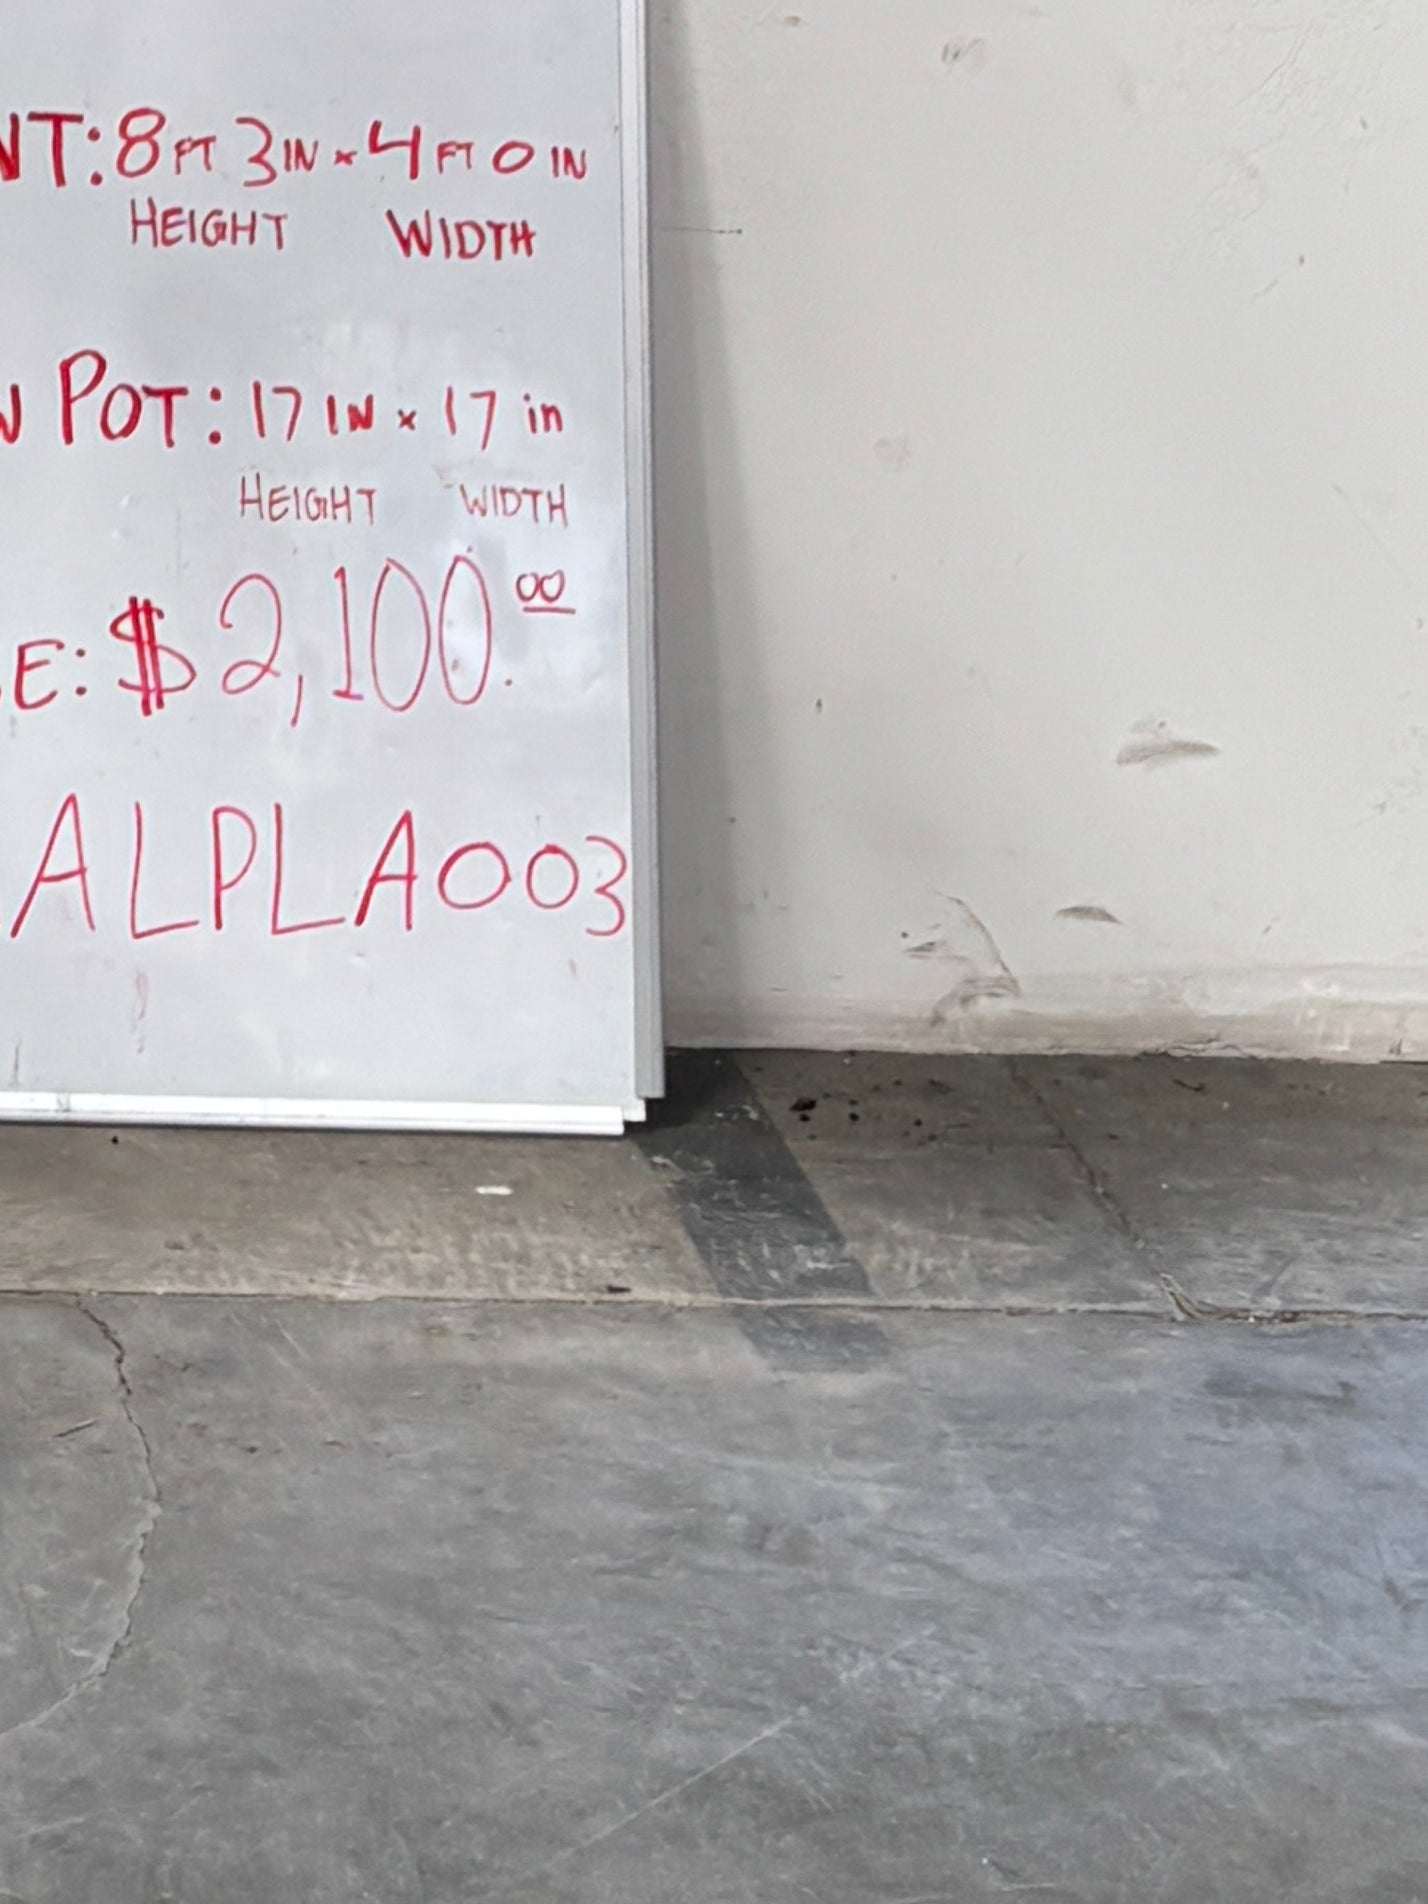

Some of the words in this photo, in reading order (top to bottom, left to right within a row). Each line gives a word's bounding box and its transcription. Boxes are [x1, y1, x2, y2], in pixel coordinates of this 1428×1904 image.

[130, 200, 288, 250] HEIGHT
[384, 211, 536, 262] WIDTH
[57, 348, 223, 449] POT:
[239, 474, 377, 524] HEIGHT
[458, 483, 569, 526] WIDTH
